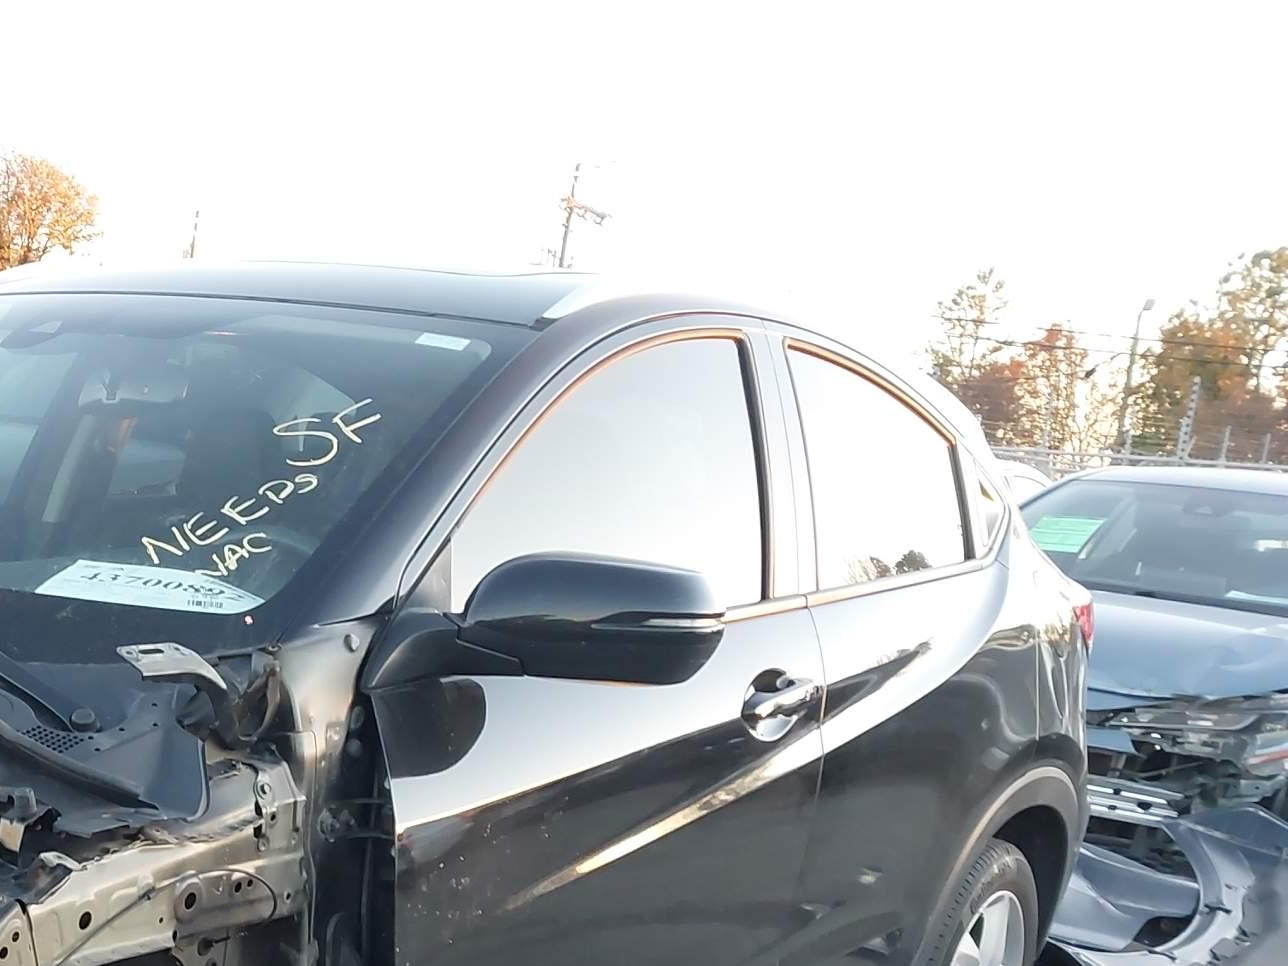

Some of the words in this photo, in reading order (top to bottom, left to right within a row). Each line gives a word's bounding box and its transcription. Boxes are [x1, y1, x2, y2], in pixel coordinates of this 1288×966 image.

[271, 397, 383, 468] SF
[140, 472, 320, 565] NEEDS
[193, 531, 274, 577] VAC
